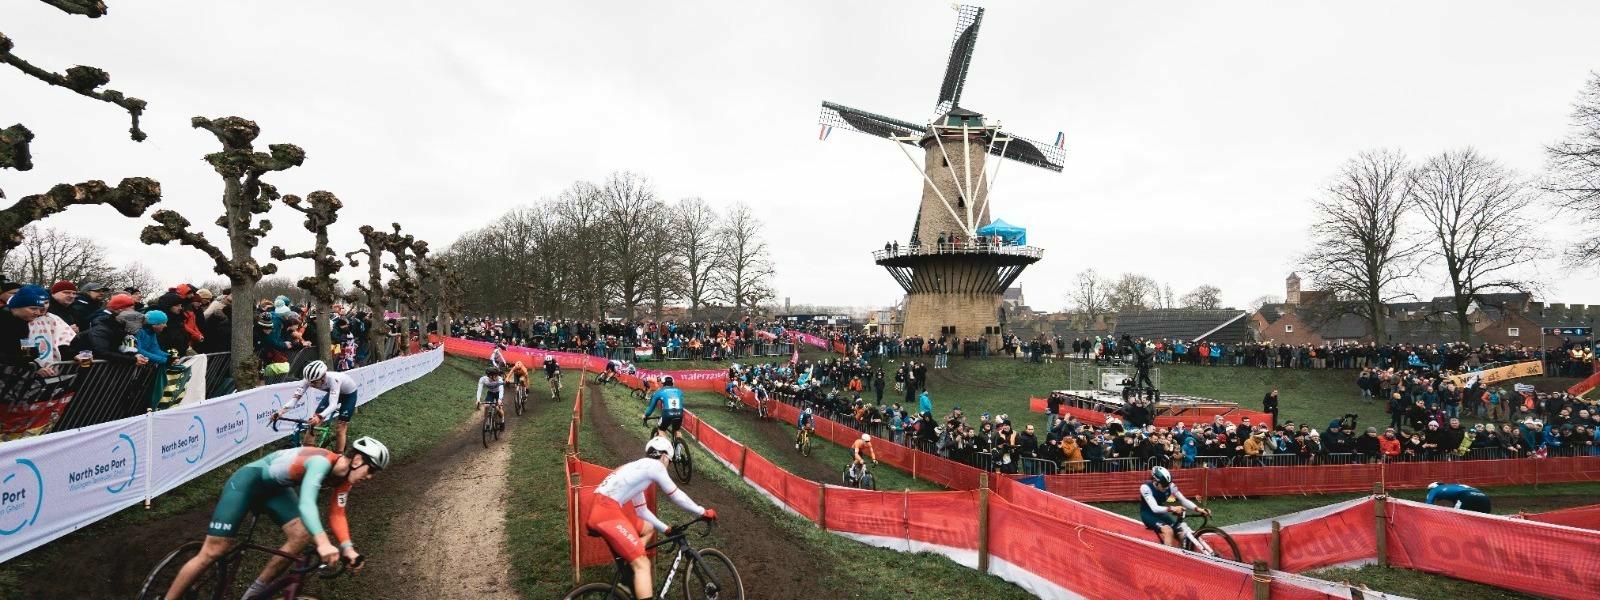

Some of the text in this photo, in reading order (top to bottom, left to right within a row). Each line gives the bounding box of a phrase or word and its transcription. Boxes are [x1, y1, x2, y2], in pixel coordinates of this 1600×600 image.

[216, 426, 228, 435] North
[236, 419, 244, 427] Port
[161, 441, 177, 454] North
[177, 439, 188, 448] Sea
[188, 434, 199, 444] Port
[69, 467, 94, 483] North
[94, 464, 110, 476] Sea
[111, 457, 126, 471] Port
[2, 487, 26, 506] Port
